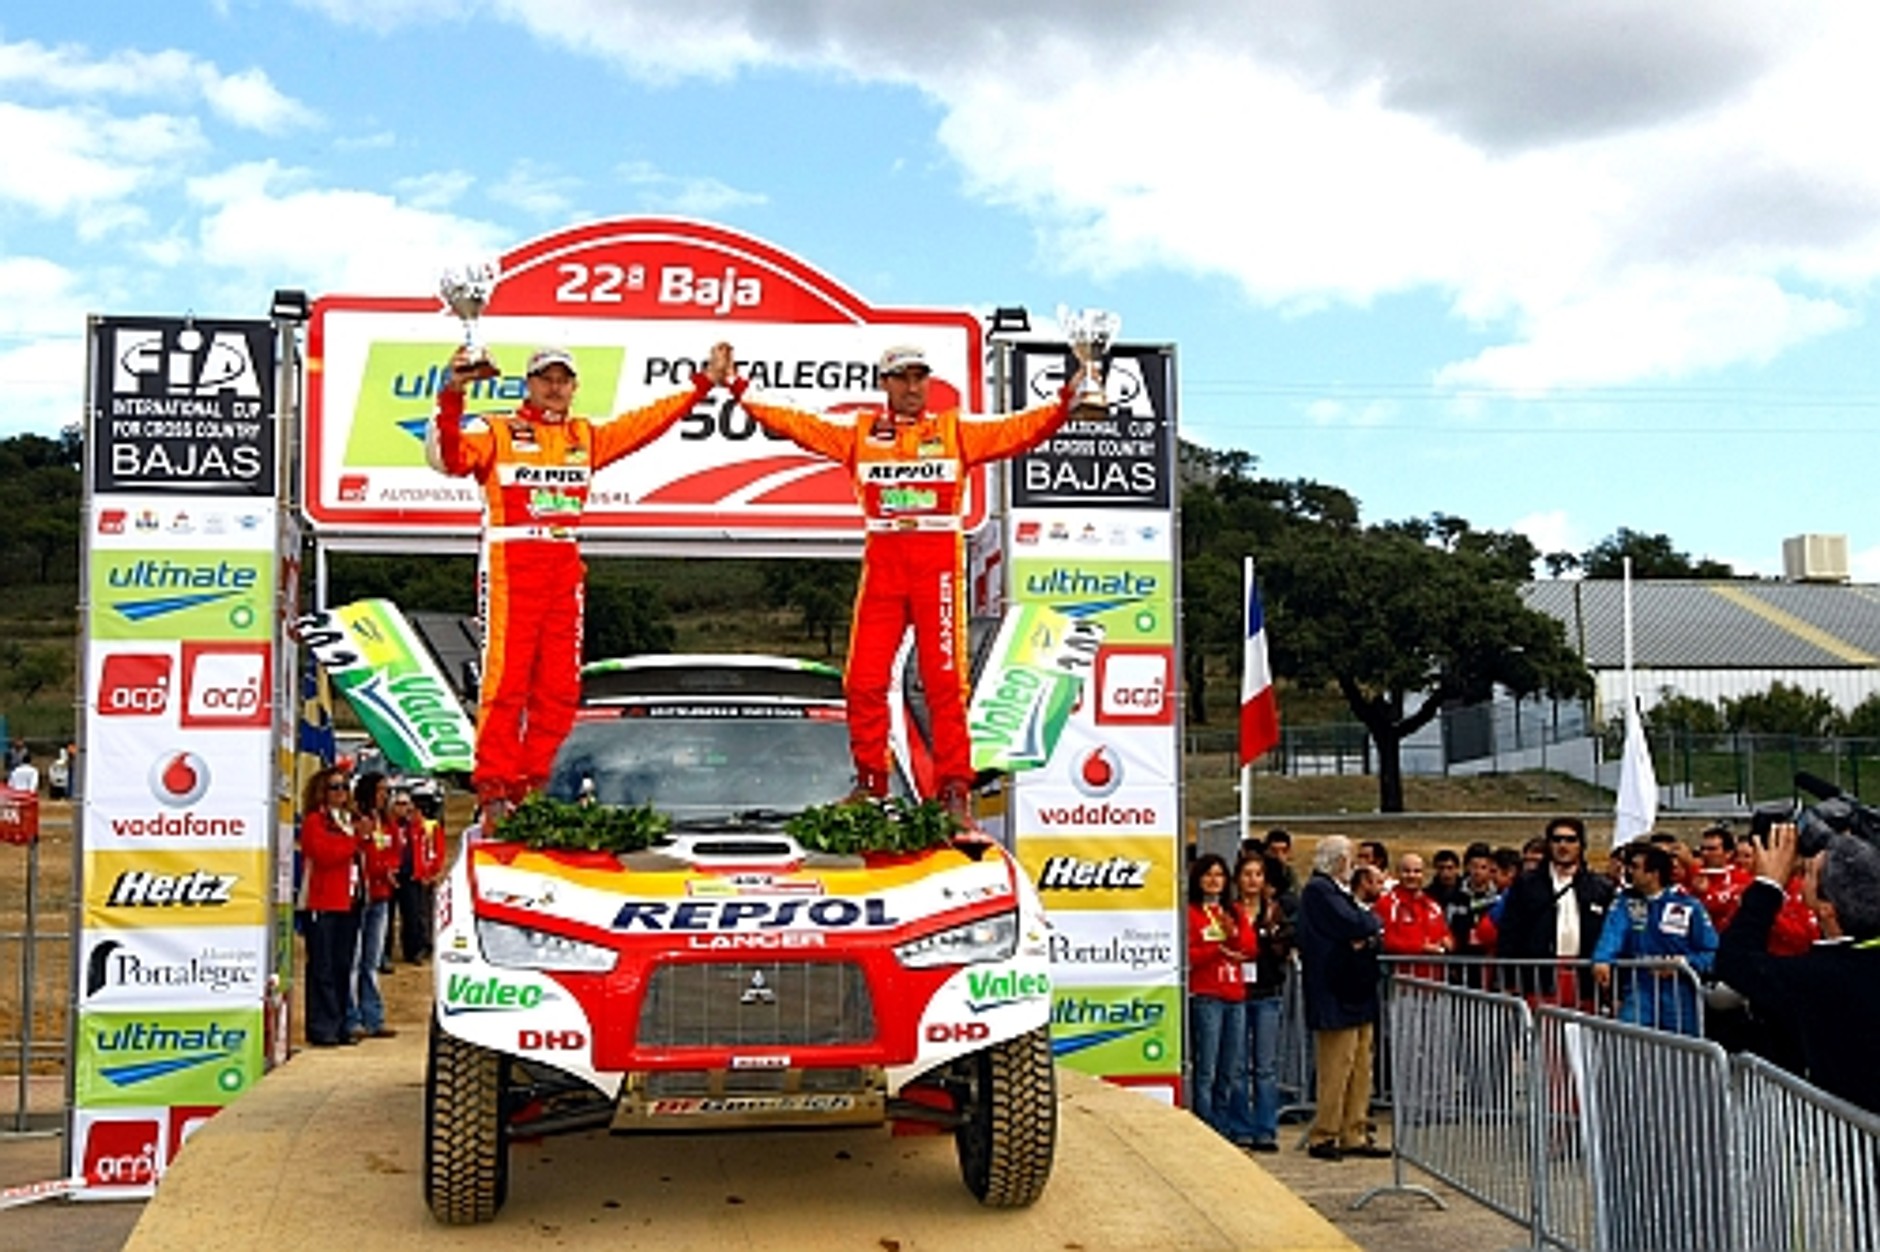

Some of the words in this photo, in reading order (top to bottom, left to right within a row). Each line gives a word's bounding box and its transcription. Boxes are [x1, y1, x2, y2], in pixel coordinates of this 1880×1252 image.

[658, 266, 762, 314] Baja
[1025, 354, 1156, 418] FA
[112, 399, 222, 417] INTERNATIONAL
[233, 402, 261, 418] CUP
[112, 421, 140, 438] FOR
[143, 421, 192, 438] CROSS
[196, 421, 261, 439] COUNTRY
[1127, 420, 1156, 437] CUP
[112, 443, 261, 478] BAJAS
[1053, 440, 1095, 456] CROSS
[1098, 440, 1156, 457] COUNTRY
[1026, 459, 1156, 492] BAJAS
[108, 560, 257, 588] ultimate
[1026, 568, 1157, 596] ultimate
[112, 687, 166, 711] acp
[203, 687, 257, 711] acp
[970, 668, 1041, 747] Valeo
[1113, 687, 1160, 707] acp
[388, 675, 473, 757] Valeo
[112, 813, 246, 836] vodafone
[1038, 803, 1156, 825] vodafone
[1038, 856, 1151, 891] Hertz
[106, 869, 240, 908] Hertz
[611, 898, 899, 930] REPSOL
[688, 932, 826, 949] LANCER
[1049, 935, 1171, 970] Portalegre
[116, 954, 257, 992] Portalegre
[967, 969, 1050, 999] Valeo
[447, 973, 544, 1009] Valeo
[98, 1022, 246, 1051] ultimate
[518, 1030, 587, 1051] DHD
[926, 1022, 990, 1042] DHD
